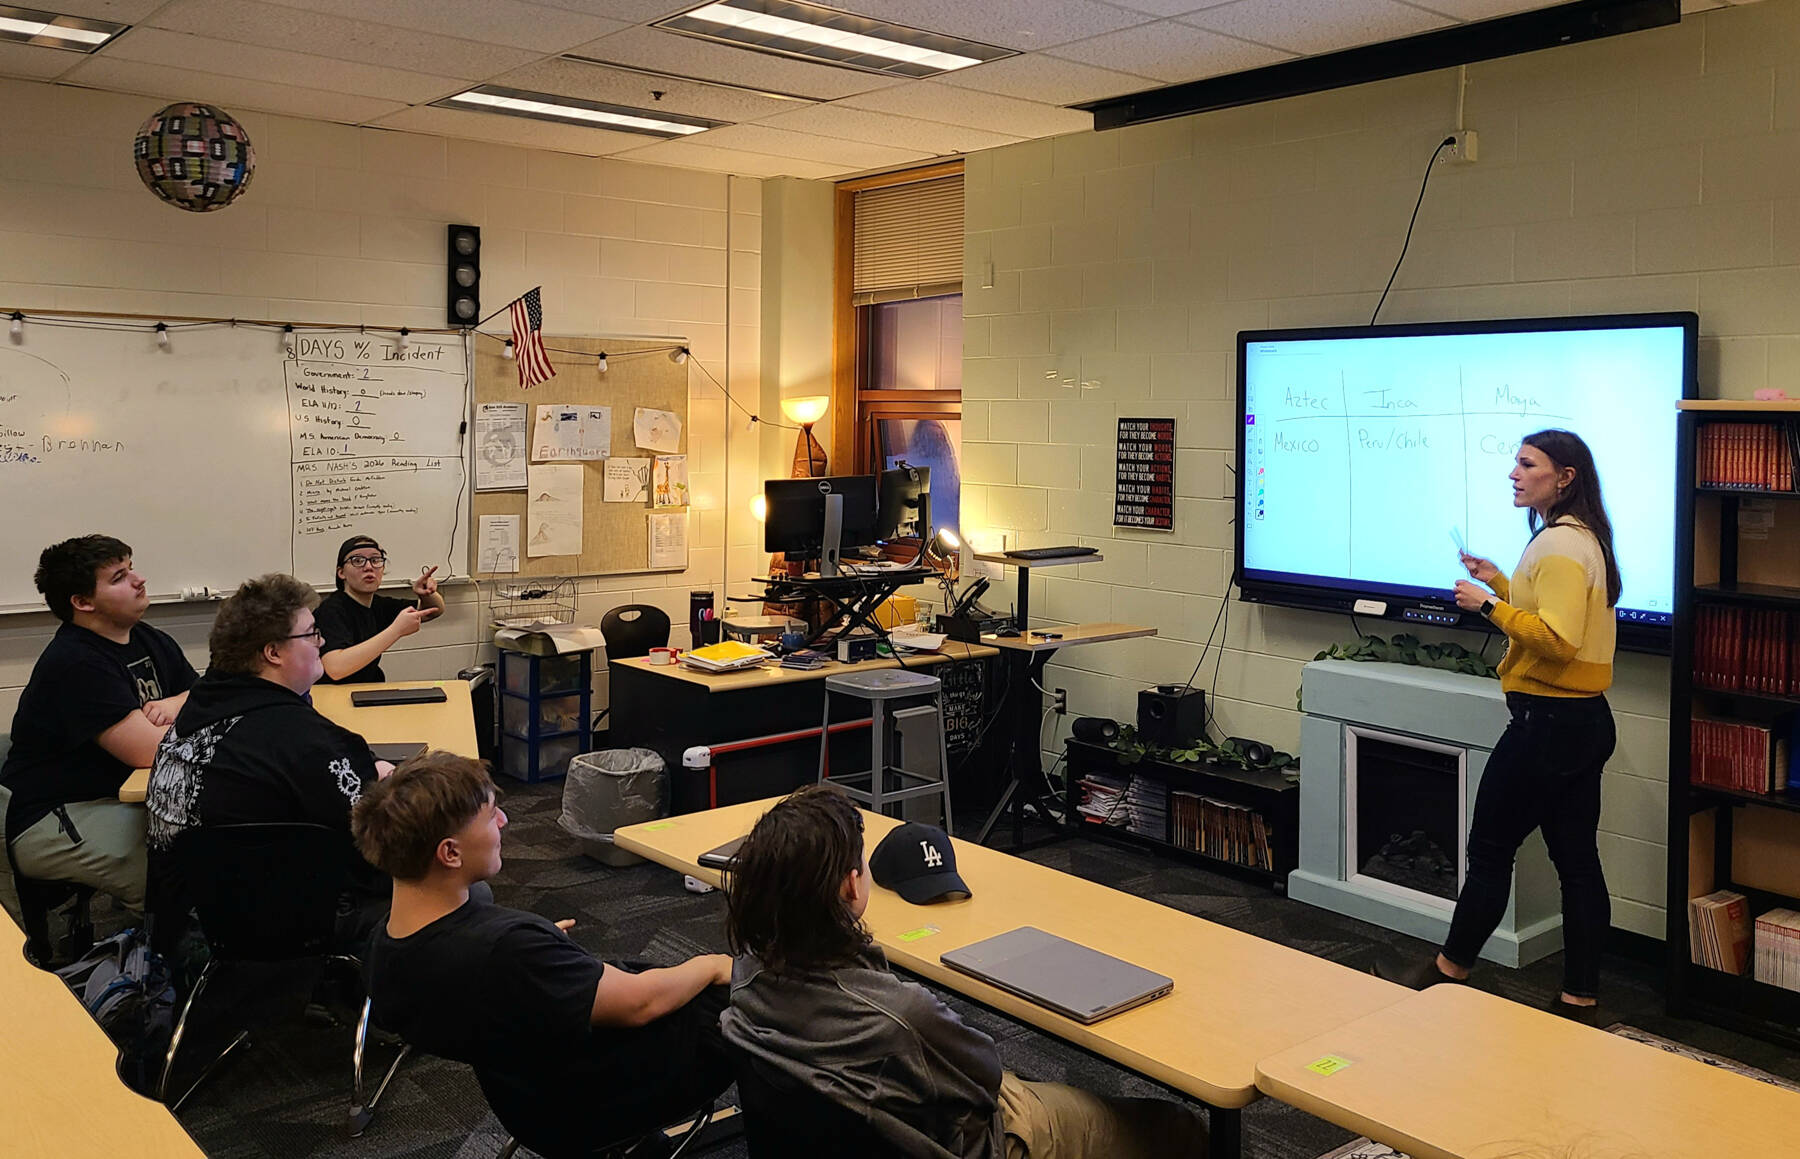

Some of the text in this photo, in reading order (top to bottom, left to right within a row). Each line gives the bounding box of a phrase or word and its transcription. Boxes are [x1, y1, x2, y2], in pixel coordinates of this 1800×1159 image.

[300, 338, 345, 360] DAYS
[379, 344, 446, 362] Incident
[294, 381, 315, 393] World
[301, 398, 319, 408] ELA
[1284, 383, 1542, 418] Aztec Inca Maya
[1119, 422, 1136, 431] WATCH
[1136, 423, 1149, 431] YOUR
[1119, 431, 1129, 439] FOR
[1129, 431, 1140, 440] THEY
[1140, 432, 1157, 440] BECOME
[1118, 442, 1137, 451] WATCH
[1138, 443, 1153, 451] YOUR
[1273, 431, 1320, 453] Mexico
[302, 446, 323, 457] ELA
[1118, 452, 1127, 460] FOR
[1127, 452, 1138, 460] THEY
[296, 462, 318, 473] MRS
[426, 457, 441, 468] List
[1118, 463, 1135, 471] WATCH
[1136, 463, 1150, 472] YOUR
[1118, 472, 1127, 480] FOR
[1127, 472, 1138, 480] THEY
[1138, 473, 1155, 481] BECOME
[1118, 484, 1135, 493] WATCH
[1136, 485, 1151, 494] YOUR
[1117, 494, 1126, 502] FOR
[1125, 494, 1135, 502] THEY
[1116, 504, 1132, 513] WATCH
[1132, 505, 1145, 514] YOUR
[946, 716, 969, 732] BIG
[919, 840, 943, 868] LA
